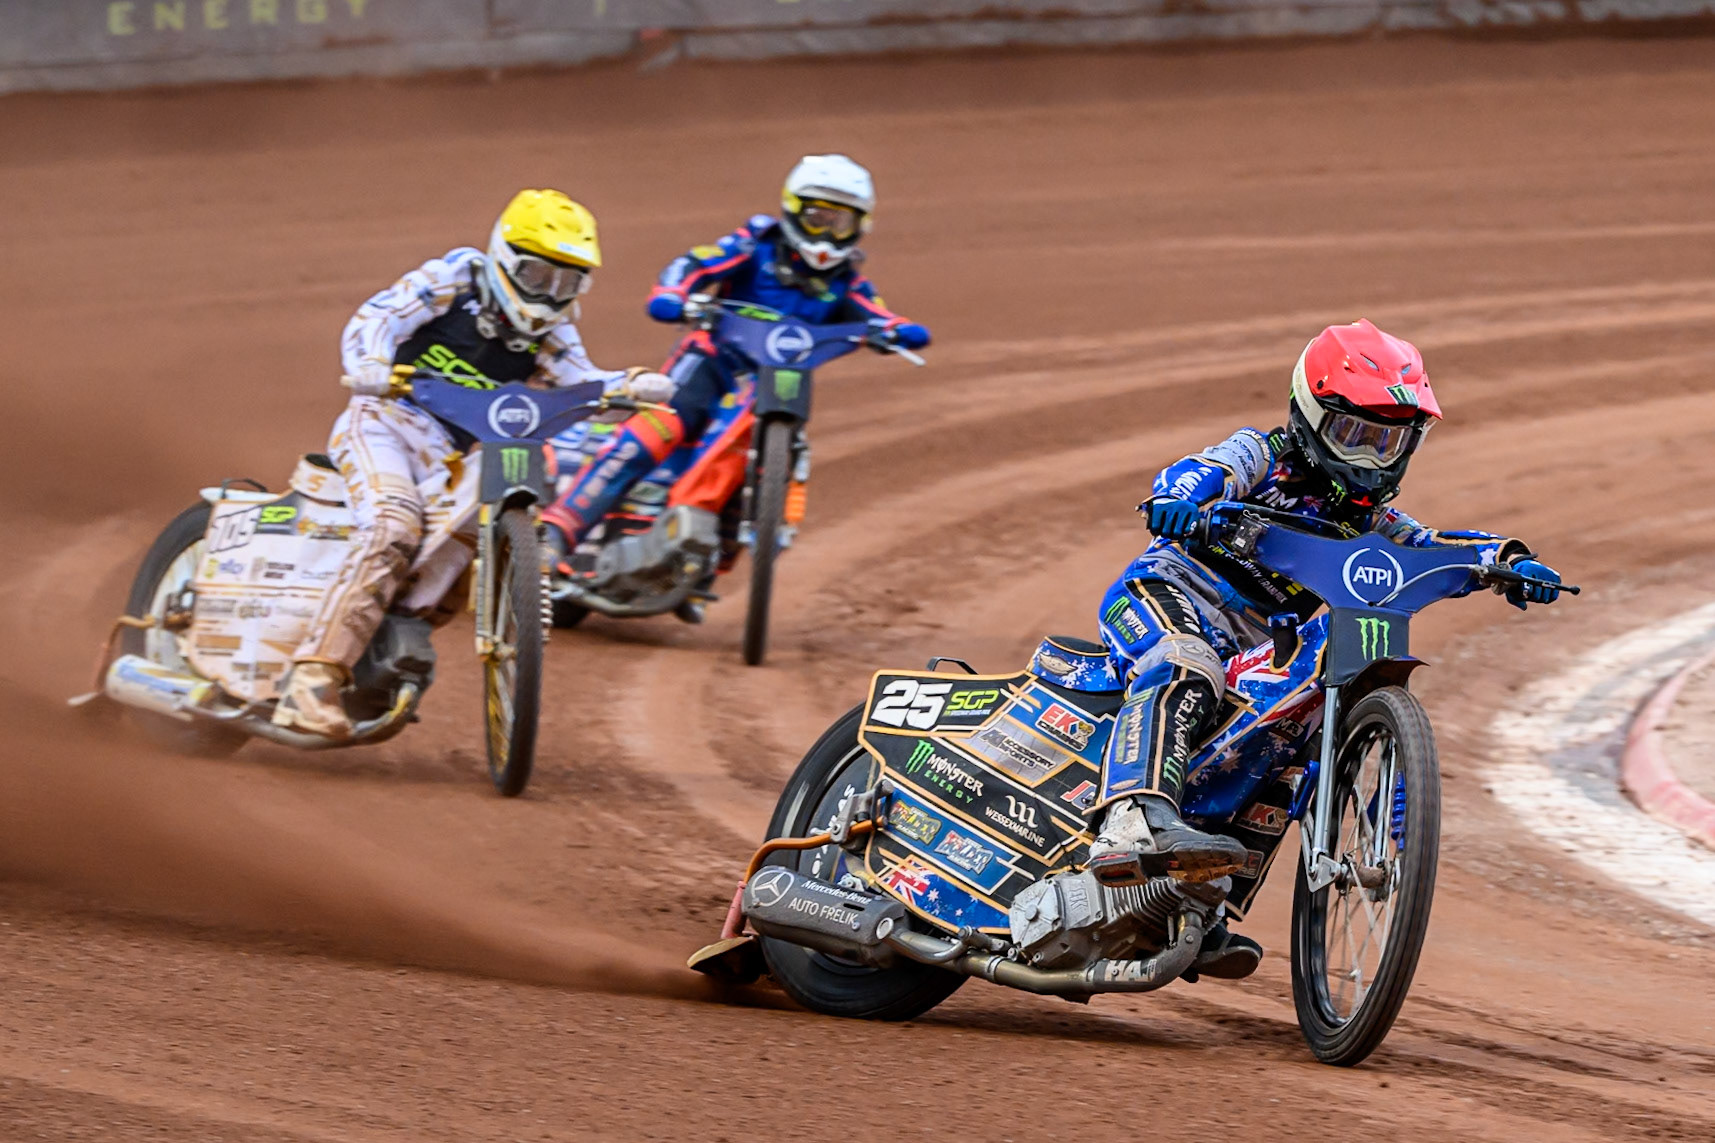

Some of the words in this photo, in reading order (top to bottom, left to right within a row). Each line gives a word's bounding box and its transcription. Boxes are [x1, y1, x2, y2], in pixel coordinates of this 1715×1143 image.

[1352, 566, 1392, 587] ATPI
[871, 680, 953, 730] 25
[946, 689, 999, 710] SGP
[1041, 704, 1079, 735] EK
[924, 770, 973, 804] ENERGY
[788, 897, 820, 916] AUTO
[819, 905, 859, 926] FRELIK
